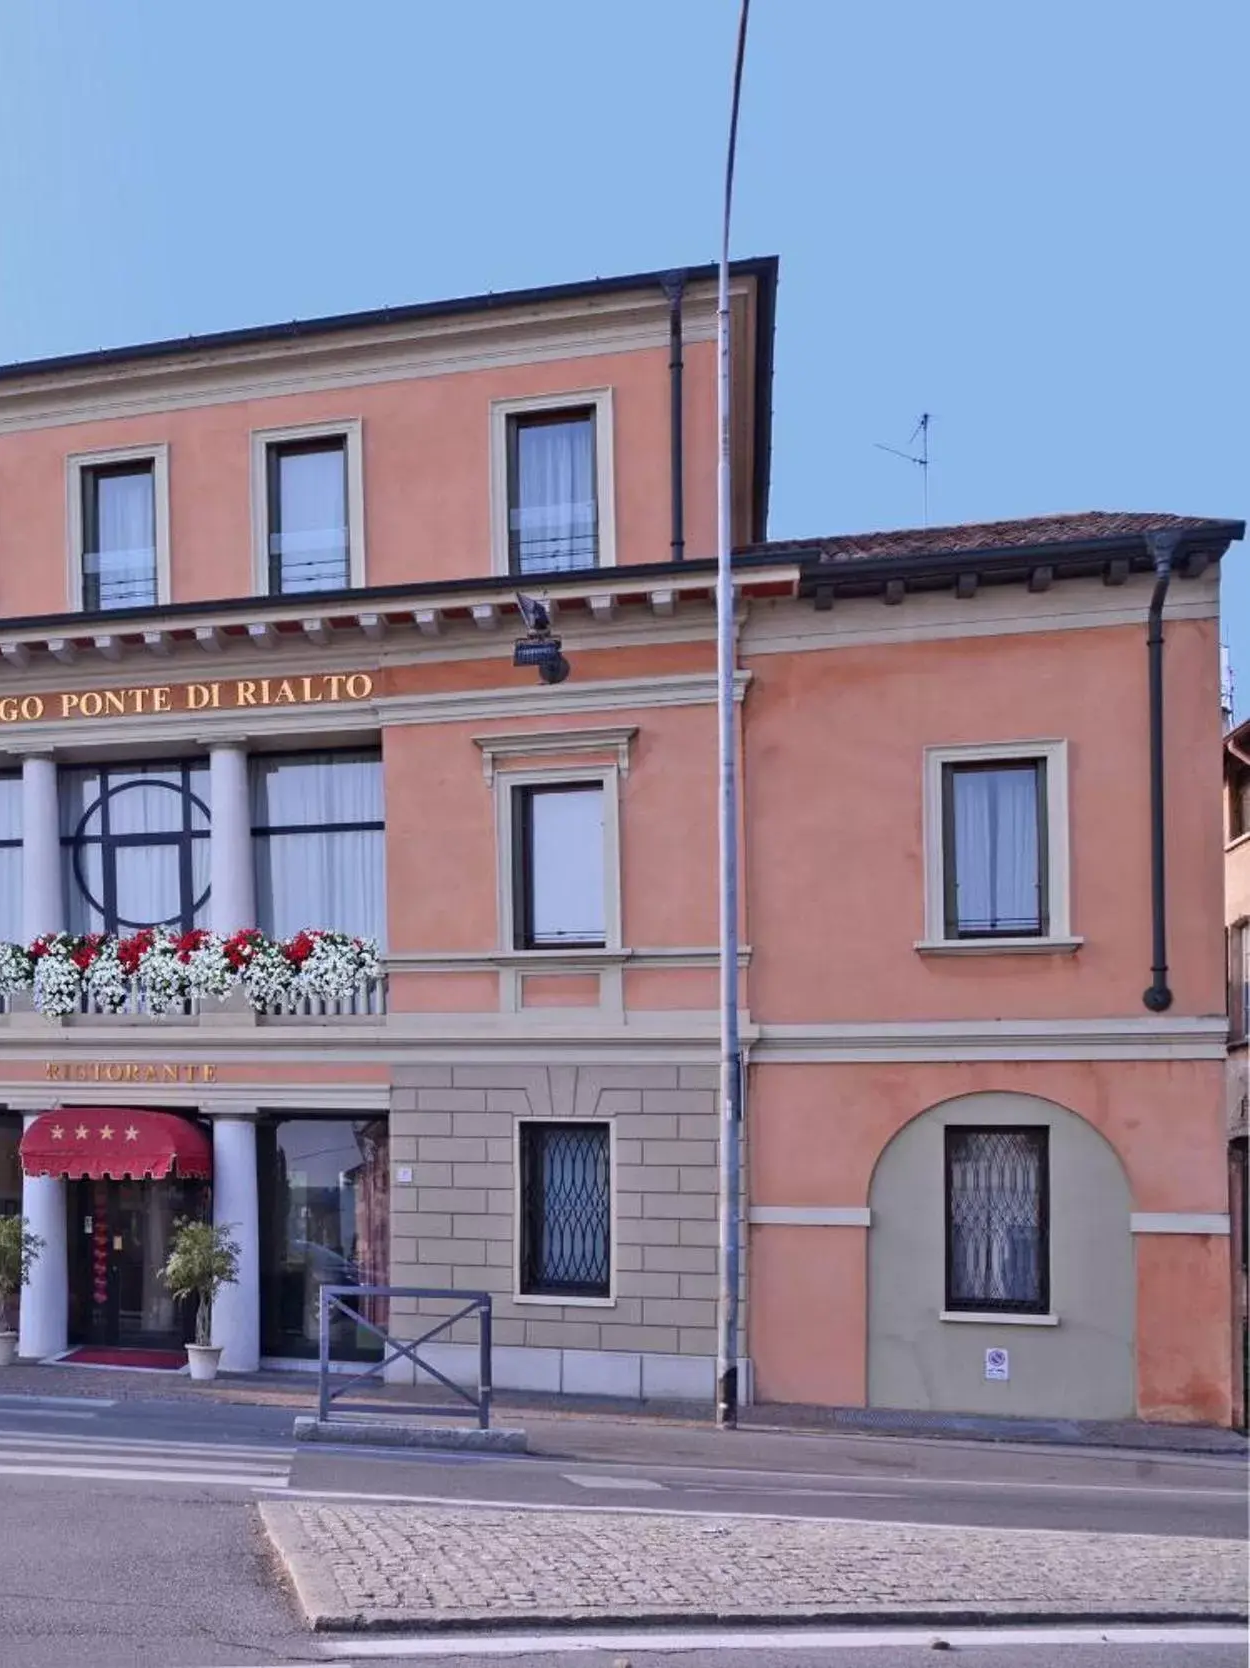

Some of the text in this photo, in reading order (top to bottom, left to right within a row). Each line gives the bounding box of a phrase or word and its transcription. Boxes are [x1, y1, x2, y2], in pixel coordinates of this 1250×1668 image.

[60, 687, 172, 717] PONTE
[187, 683, 220, 709] DI
[236, 674, 373, 706] RIALTO
[45, 1063, 218, 1083] RISTORANTE
